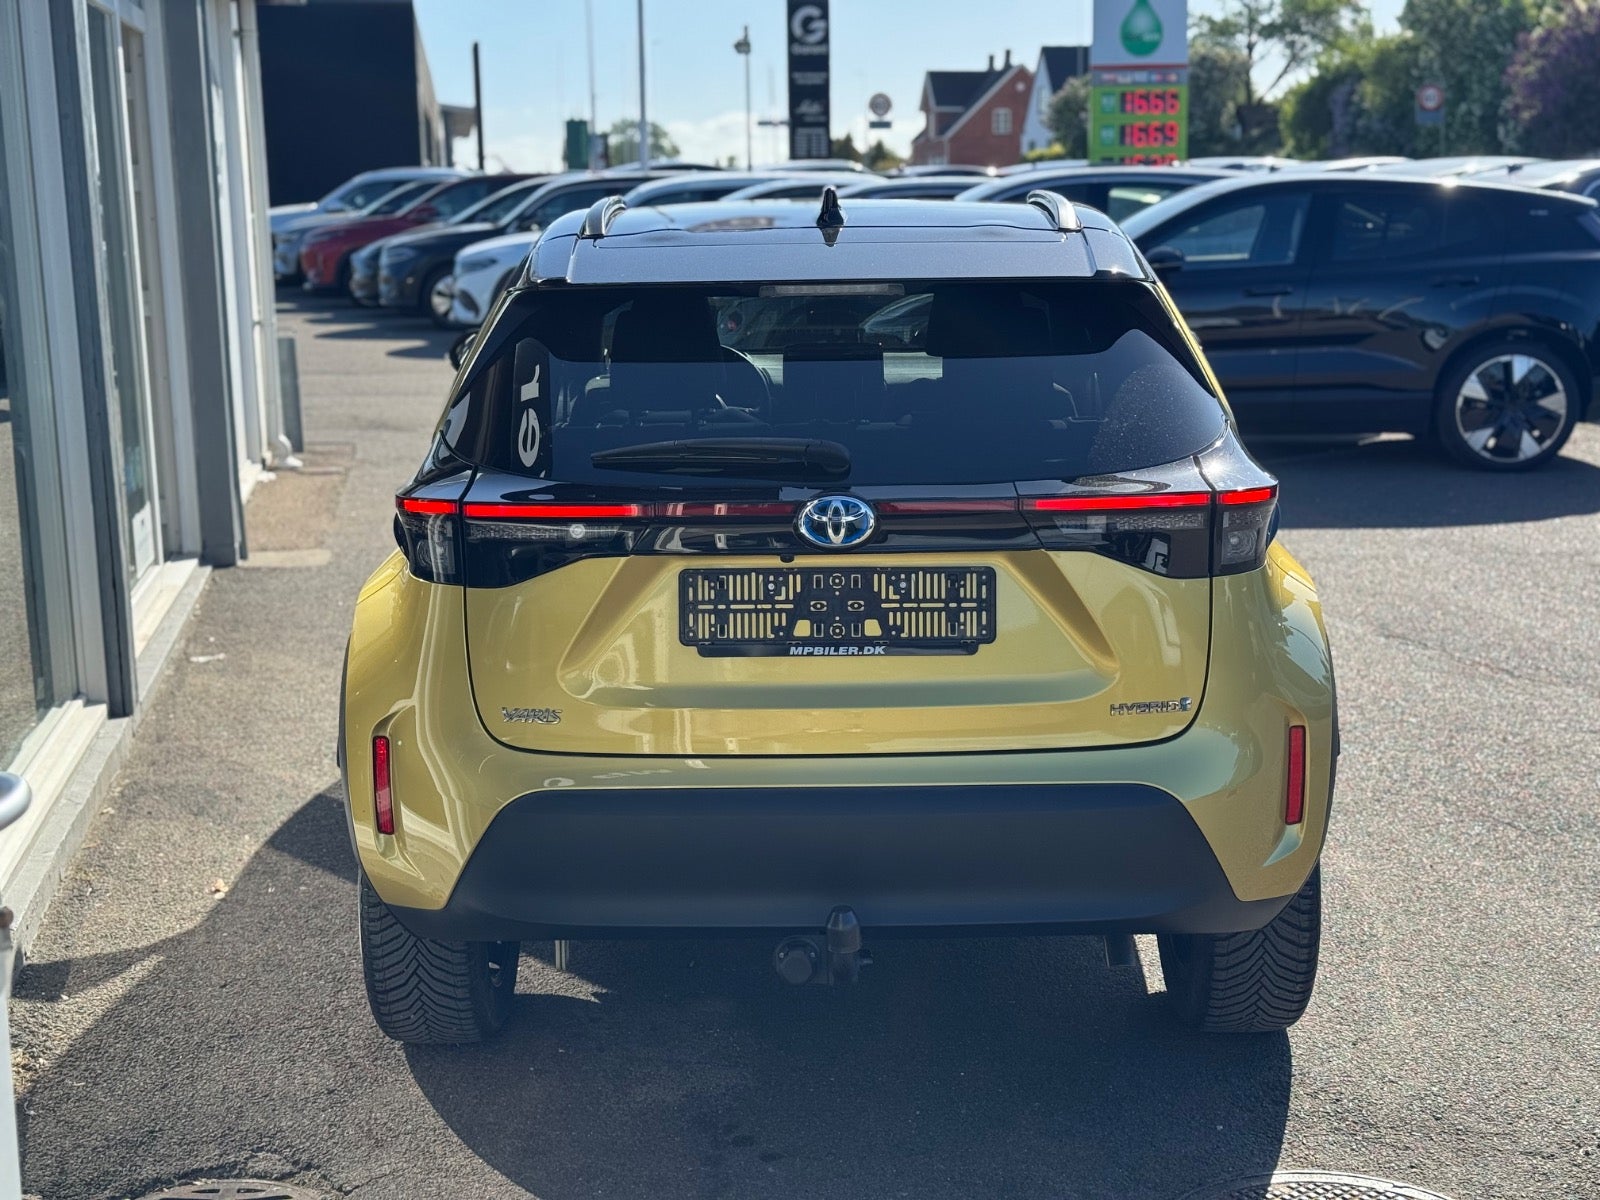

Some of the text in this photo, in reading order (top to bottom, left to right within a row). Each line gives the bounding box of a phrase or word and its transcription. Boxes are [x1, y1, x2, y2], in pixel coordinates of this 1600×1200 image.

[791, 4, 828, 43] G
[789, 646, 887, 656] MPBILER.DK
[501, 706, 563, 725] YARIS
[1110, 700, 1181, 716] HYBRID
